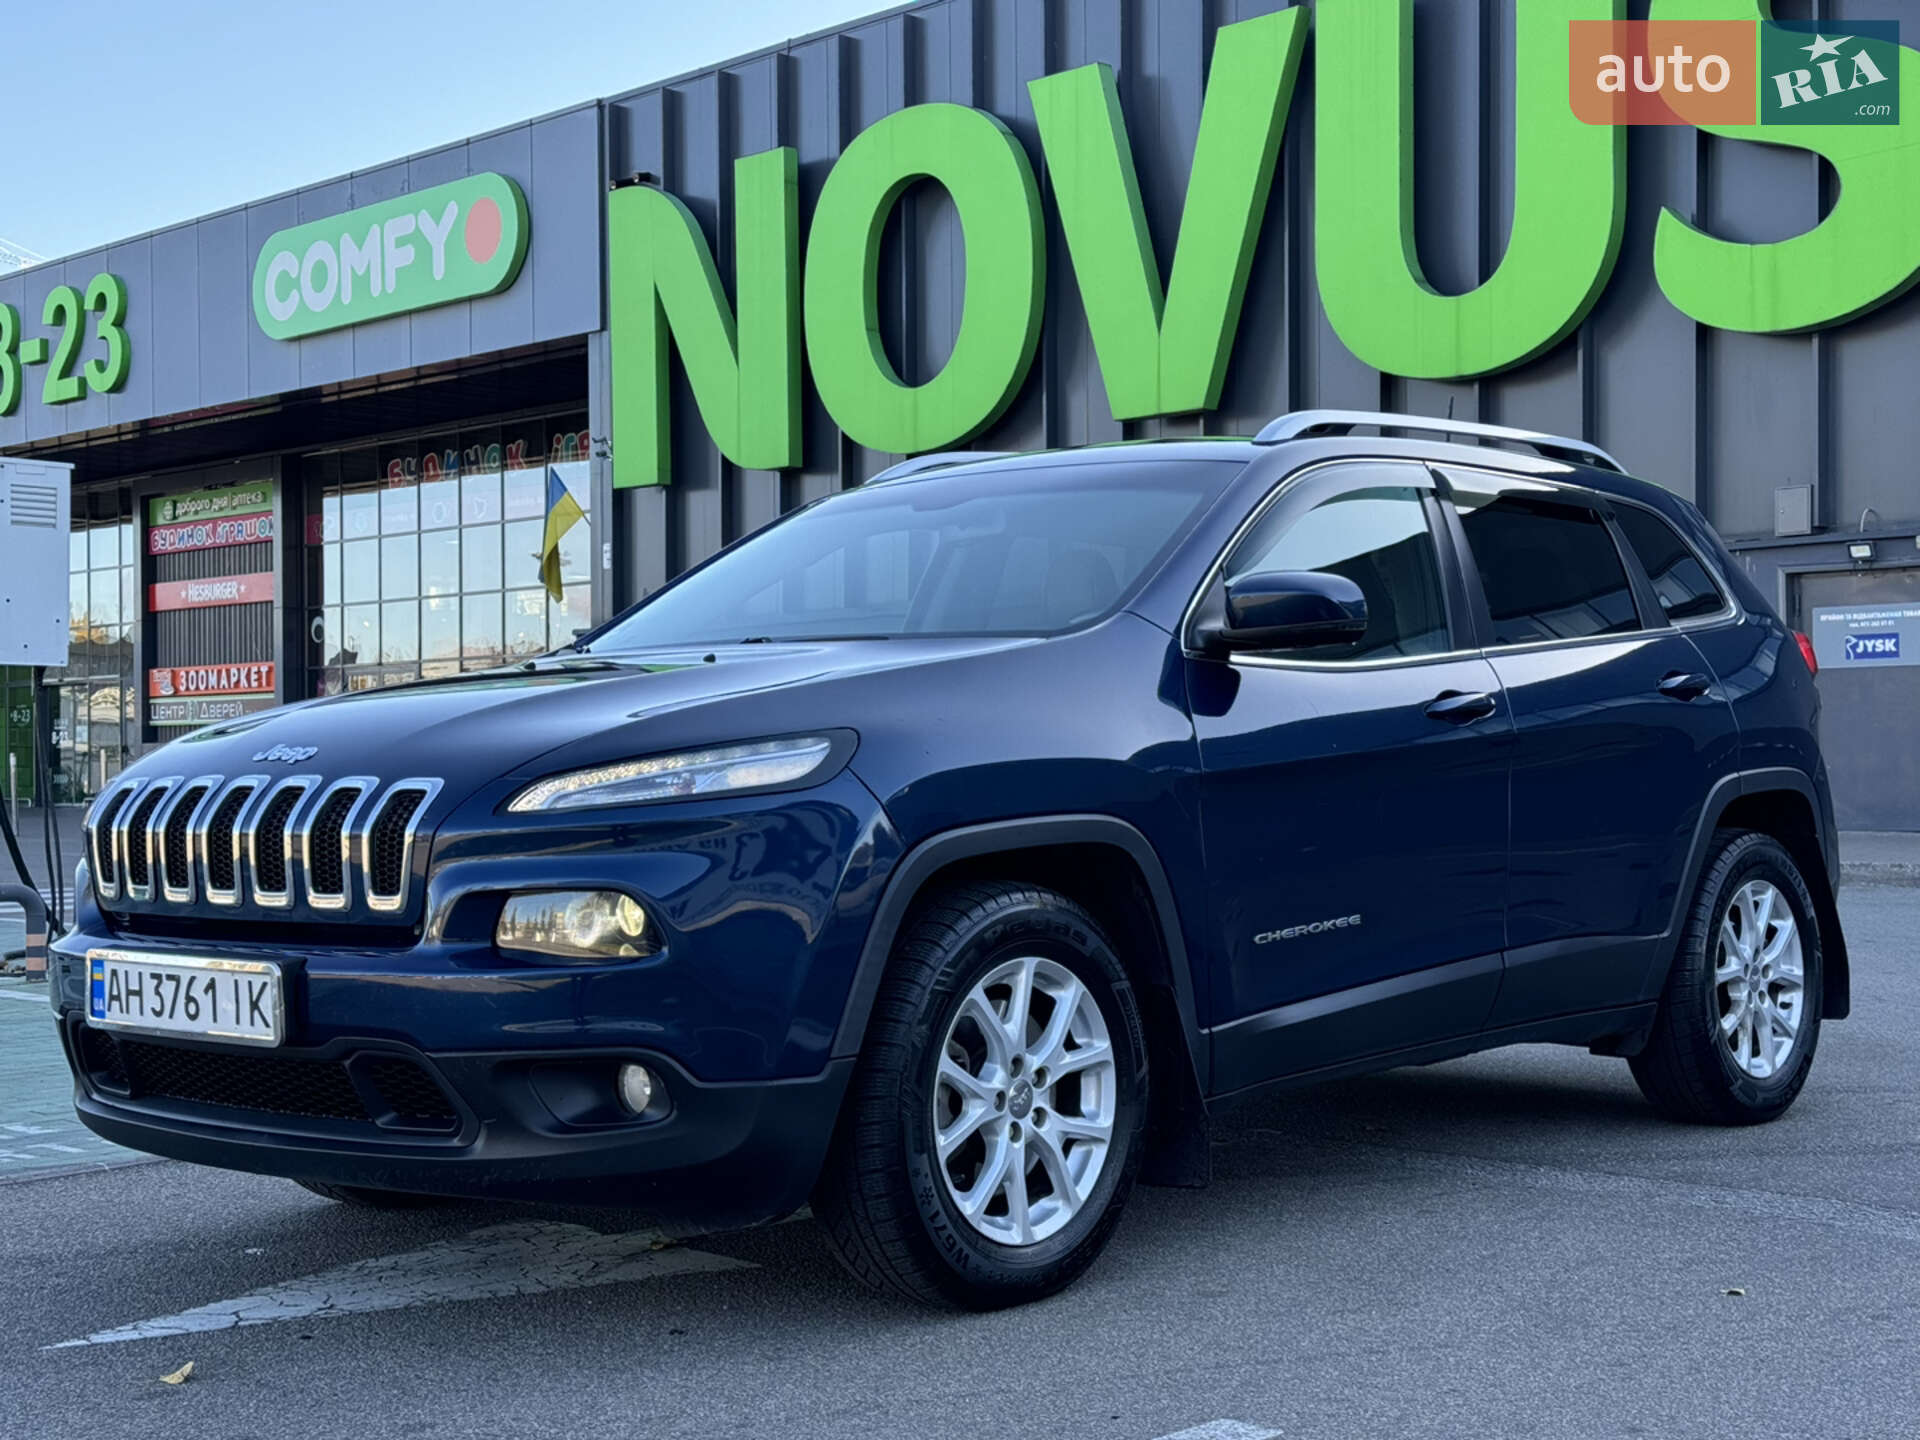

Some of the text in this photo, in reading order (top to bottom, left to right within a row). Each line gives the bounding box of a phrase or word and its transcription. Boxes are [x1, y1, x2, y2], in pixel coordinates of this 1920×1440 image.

[608, 0, 1920, 488] NOVUS
[264, 200, 459, 322] COMFY
[151, 523, 214, 551] БУДИНОК
[188, 581, 239, 603] HESBURGER
[1855, 638, 1897, 653] JYSK
[179, 665, 269, 692] ЗООМАРКЕТ
[151, 704, 185, 720] ЦЕНТР
[252, 743, 319, 764] Jeep
[1253, 913, 1362, 945] CHEROKEE
